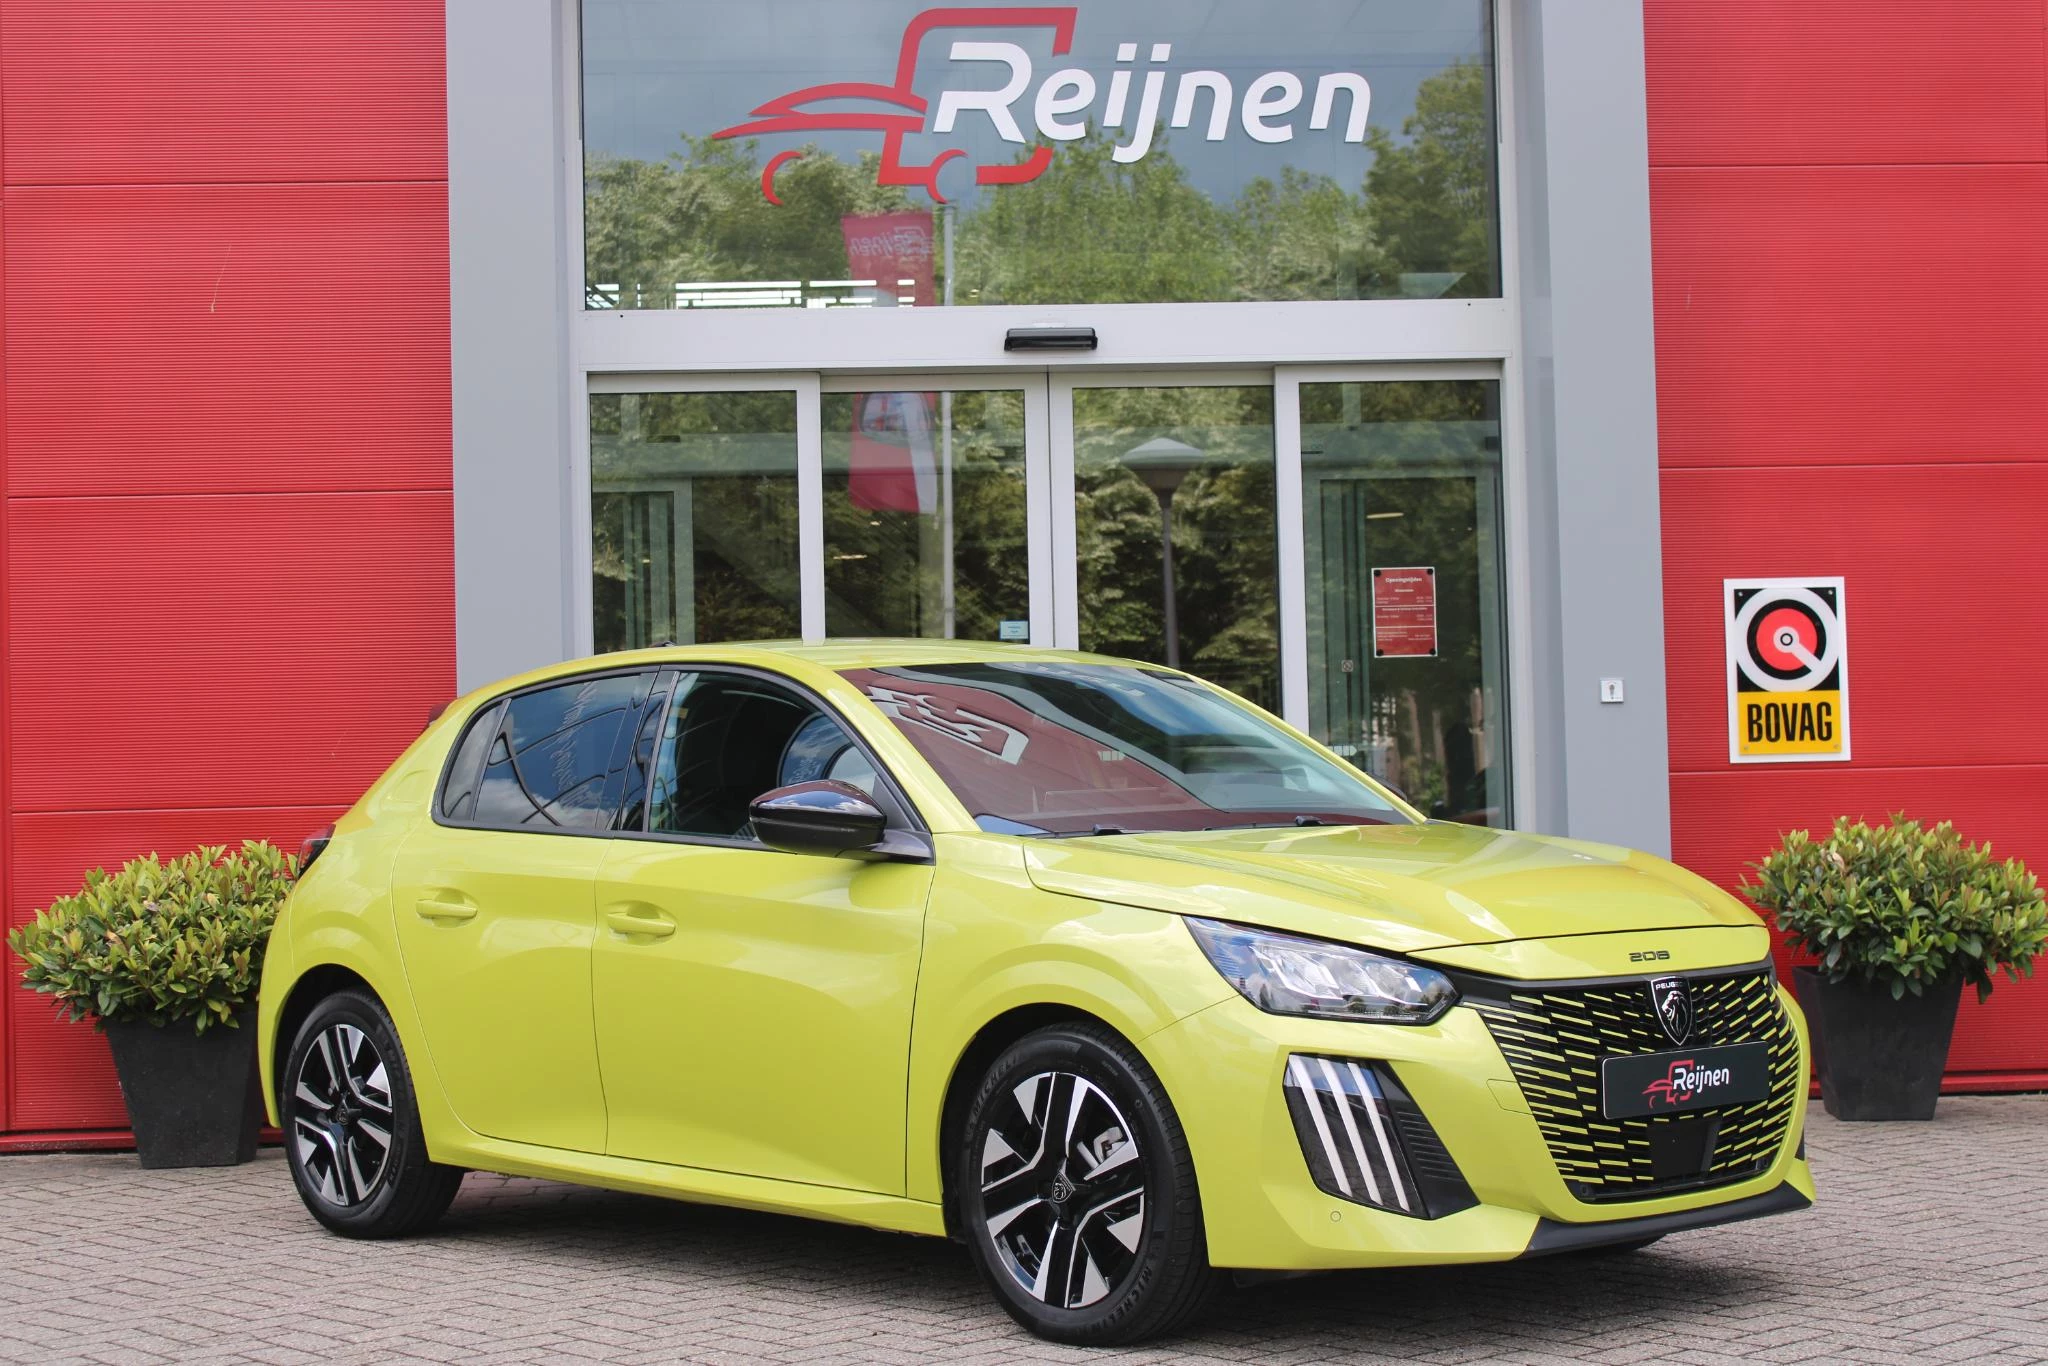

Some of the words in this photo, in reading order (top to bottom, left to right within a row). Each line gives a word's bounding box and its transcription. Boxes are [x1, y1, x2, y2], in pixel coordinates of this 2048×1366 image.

[933, 41, 1372, 164] Reijnen
[1747, 701, 1833, 743] BOVAG
[1628, 950, 1671, 963] 208
[1655, 981, 1684, 991] PEUGE
[1672, 1065, 1730, 1093] Reijnen
